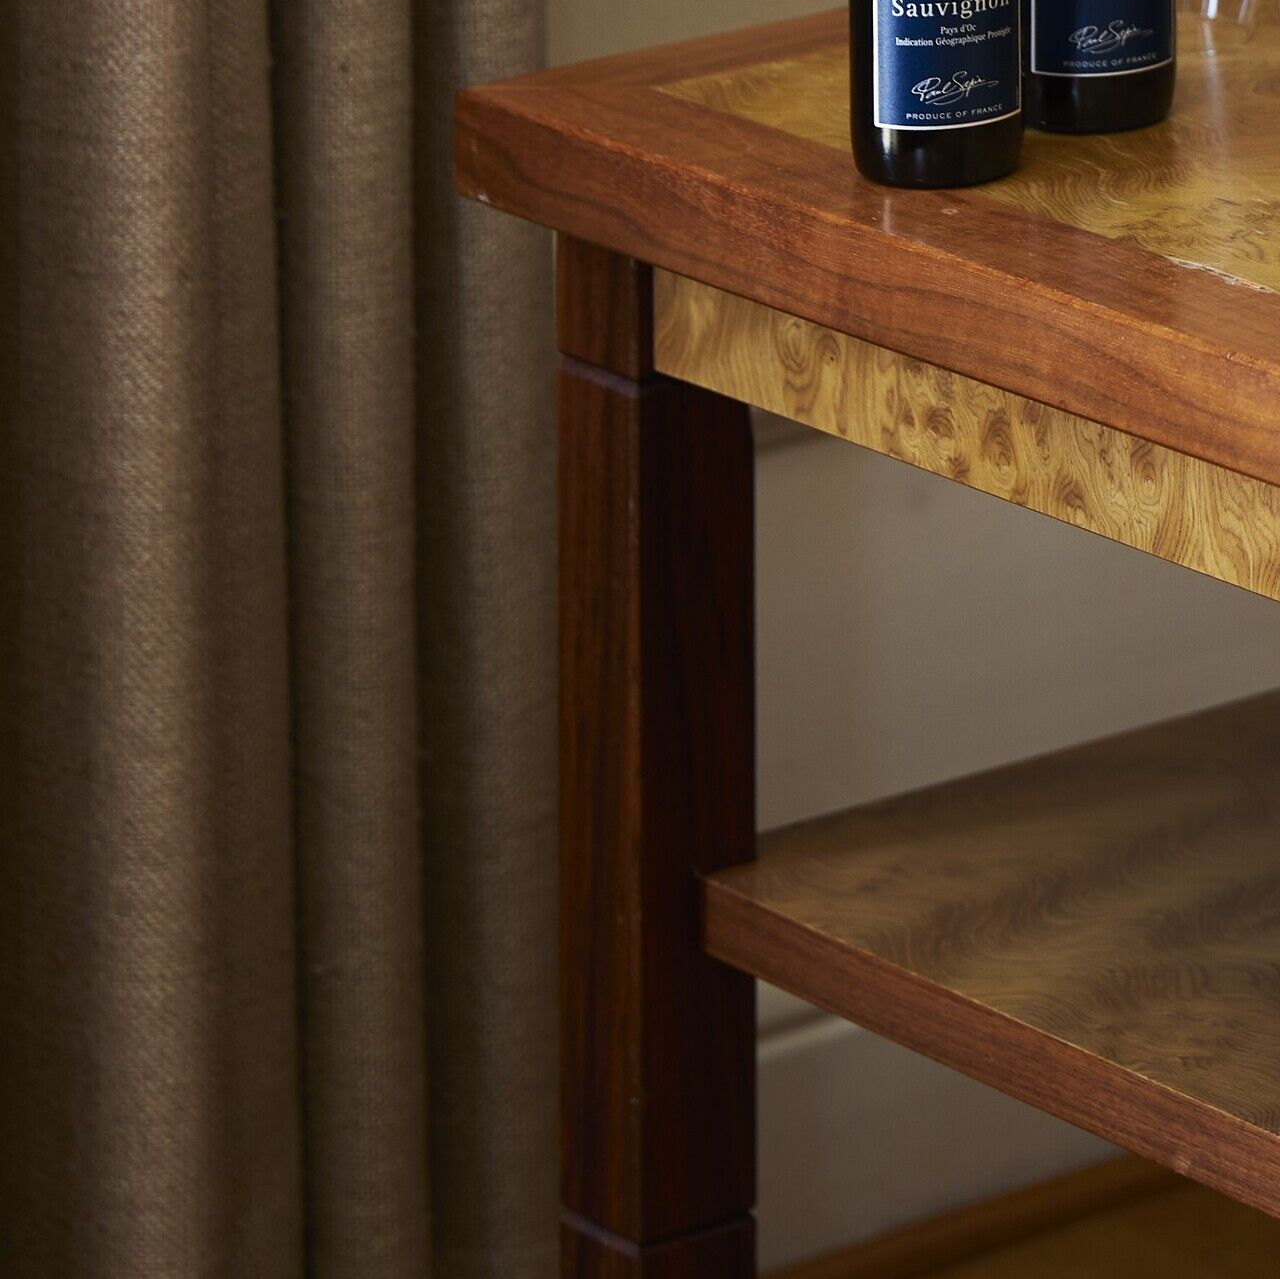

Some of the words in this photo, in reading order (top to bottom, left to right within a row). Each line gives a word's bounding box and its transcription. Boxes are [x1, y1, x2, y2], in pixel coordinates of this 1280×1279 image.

[940, 25, 957, 36] Pays
[895, 37, 933, 46] Indication
[906, 112, 952, 120] PRODUCE
[971, 104, 1003, 115] FRANCE
